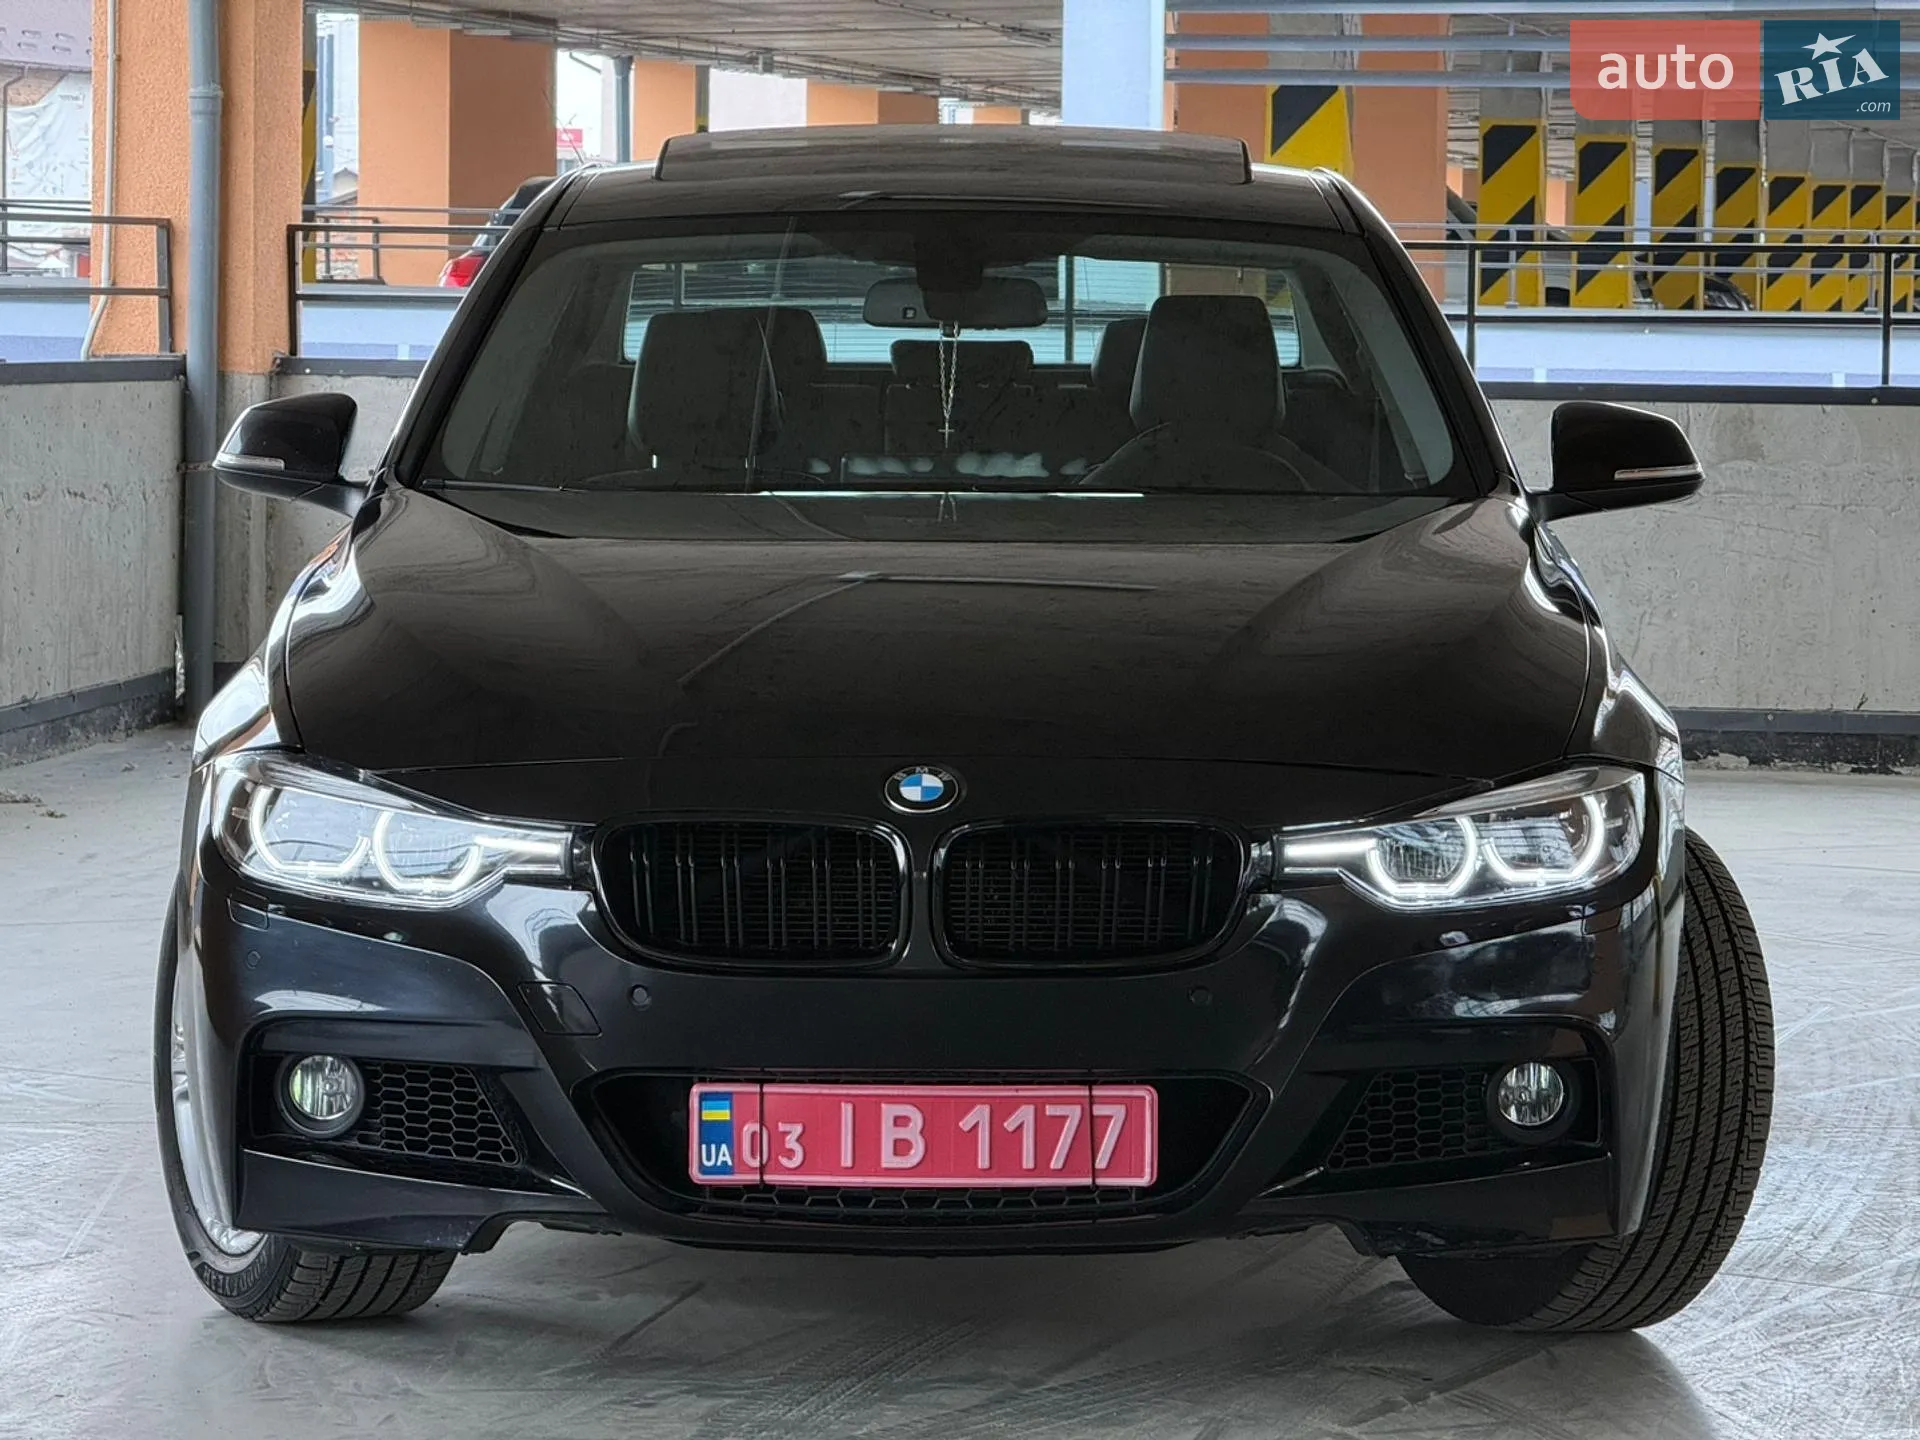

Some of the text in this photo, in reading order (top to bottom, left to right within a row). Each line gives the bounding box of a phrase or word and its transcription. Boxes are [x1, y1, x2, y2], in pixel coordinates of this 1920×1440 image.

[701, 1143, 732, 1166] UA
[742, 1122, 804, 1169] 03
[958, 1103, 1127, 1169] 1177
